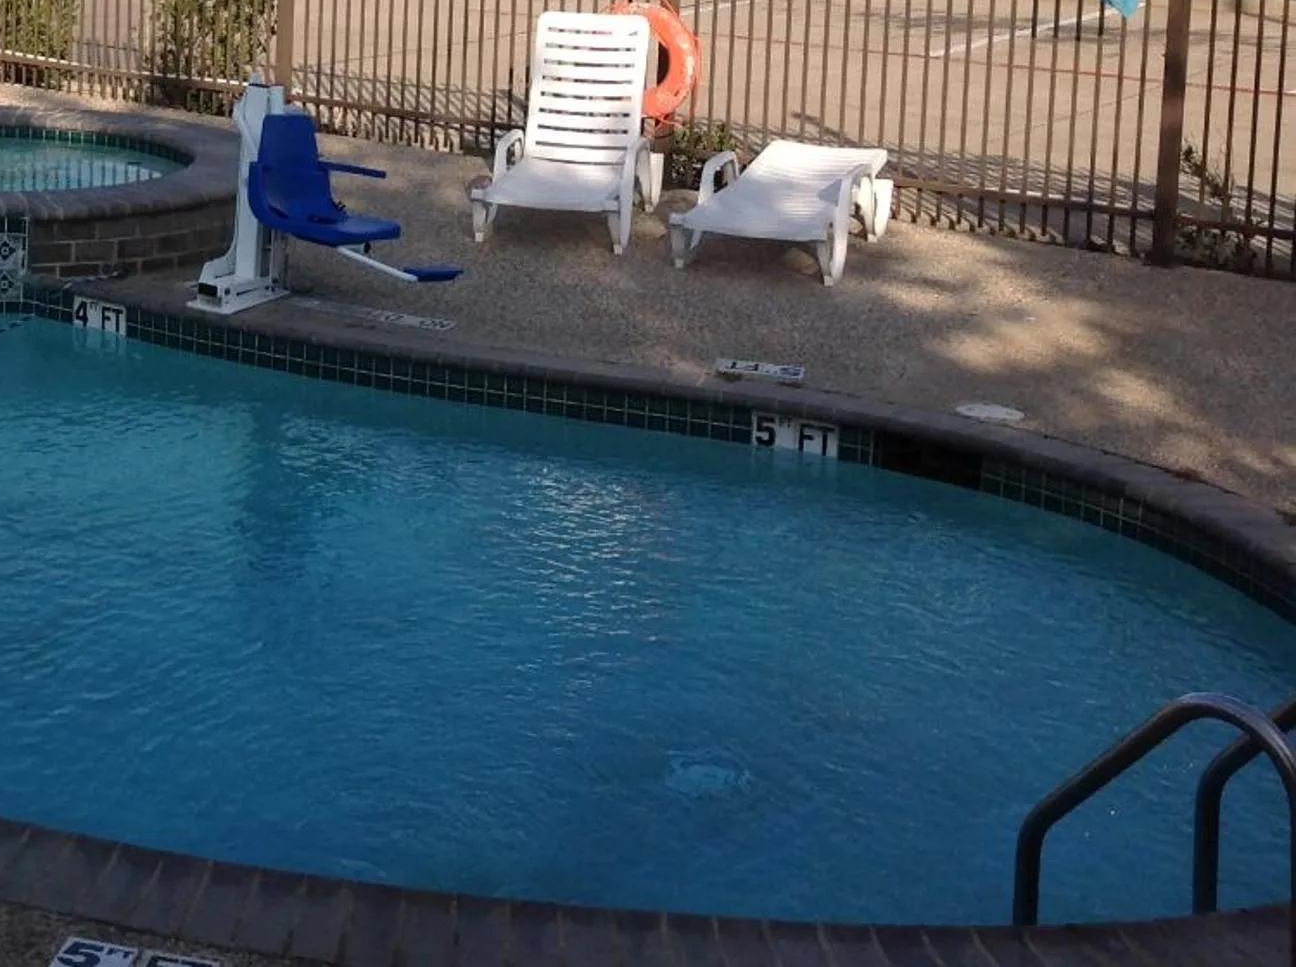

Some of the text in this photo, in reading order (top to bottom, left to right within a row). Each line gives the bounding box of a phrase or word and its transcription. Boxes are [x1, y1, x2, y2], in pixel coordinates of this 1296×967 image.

[75, 301, 89, 328] 4
[101, 306, 124, 333] FT
[755, 416, 777, 447] 5
[798, 423, 837, 457] FT
[56, 940, 104, 967] 5
